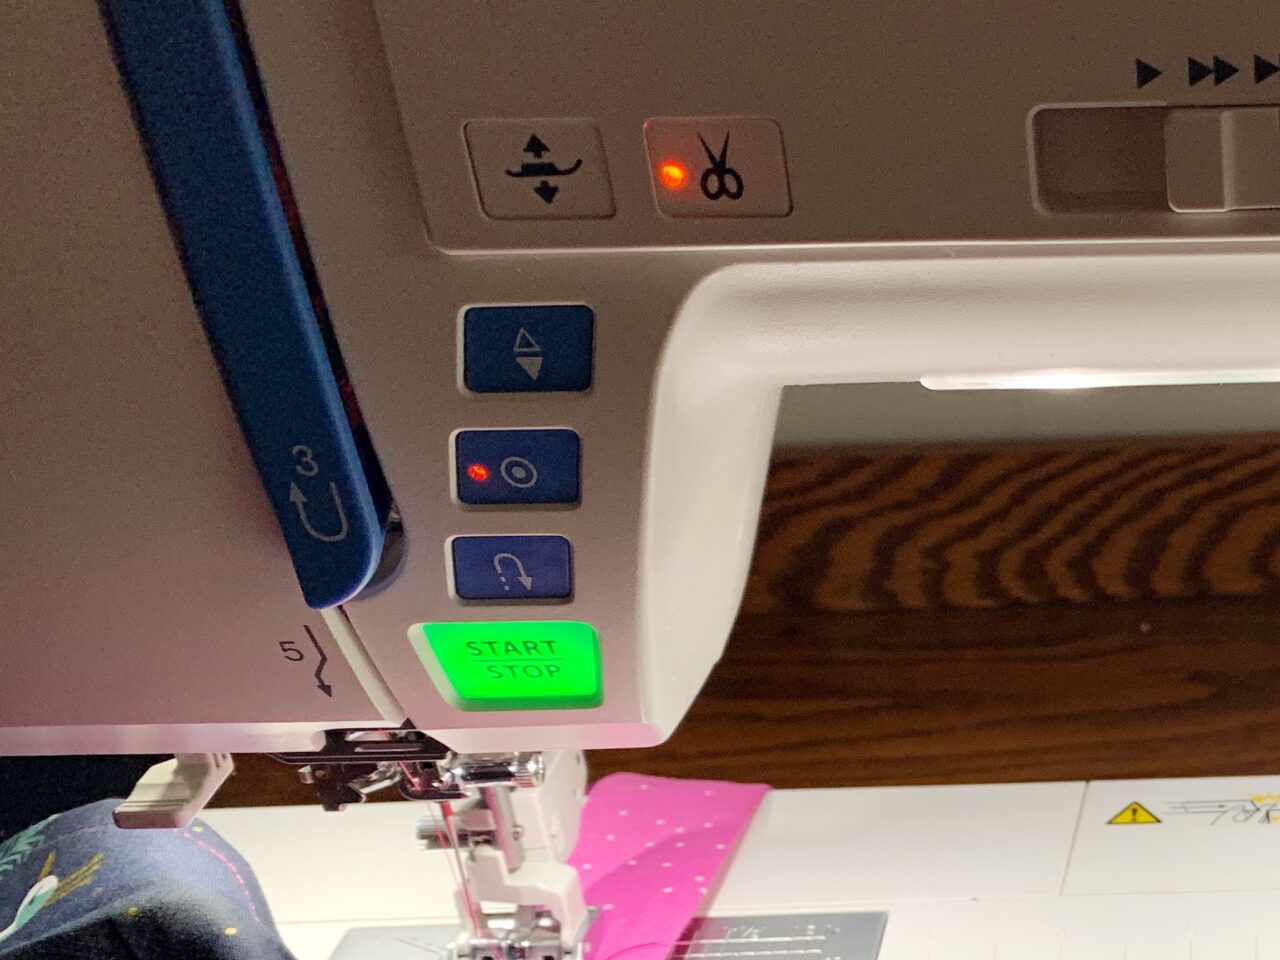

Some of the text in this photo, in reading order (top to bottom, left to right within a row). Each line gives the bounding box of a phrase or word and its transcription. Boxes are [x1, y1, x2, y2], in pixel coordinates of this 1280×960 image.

[292, 446, 319, 476] 3
[280, 641, 303, 661] 5
[464, 639, 557, 658] START
[487, 664, 561, 680] STOP
